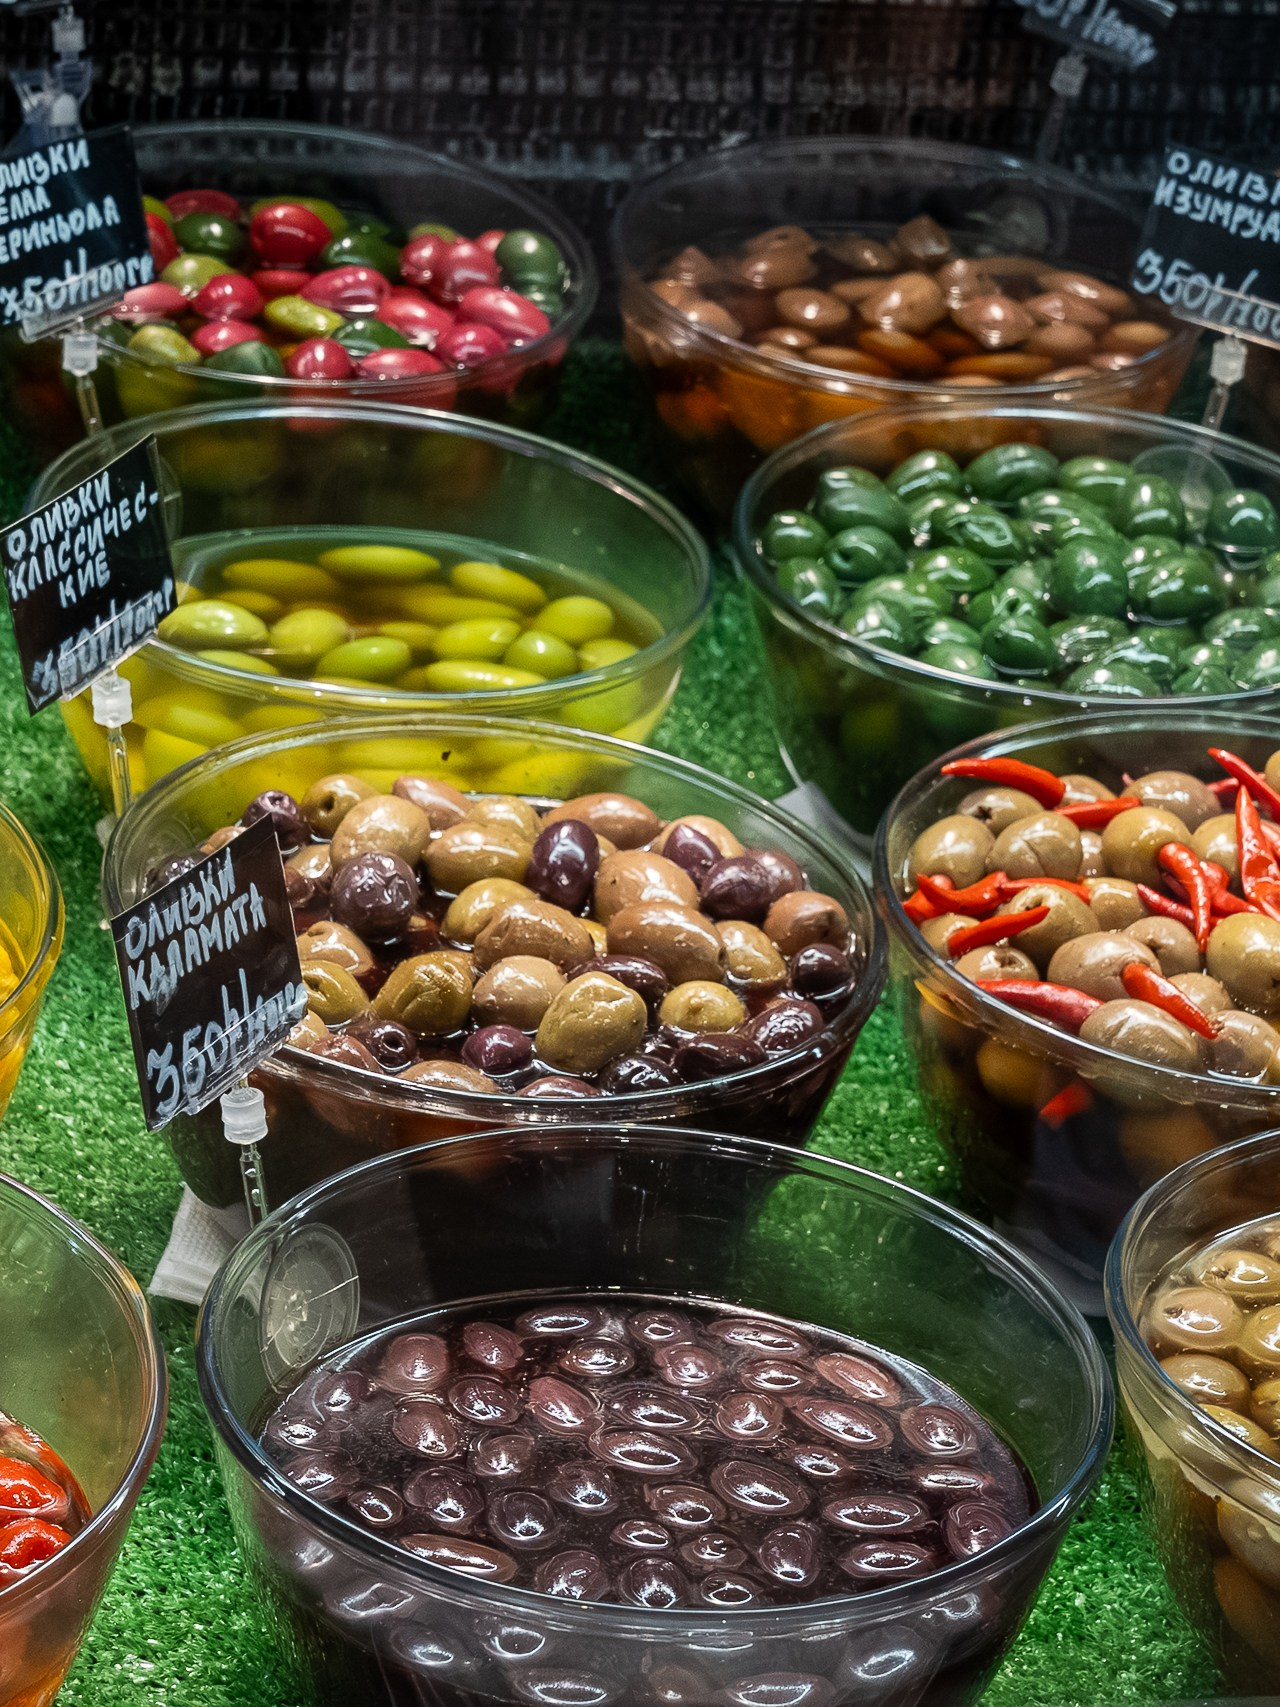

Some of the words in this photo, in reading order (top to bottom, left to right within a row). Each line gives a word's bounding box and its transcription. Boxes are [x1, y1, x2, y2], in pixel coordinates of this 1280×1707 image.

[7, 471, 111, 560] ОЛИВКИ
[59, 550, 111, 608] КИЕ
[125, 847, 236, 960] ОЛИВКИ
[128, 882, 266, 1010] КАЛАМАТА
